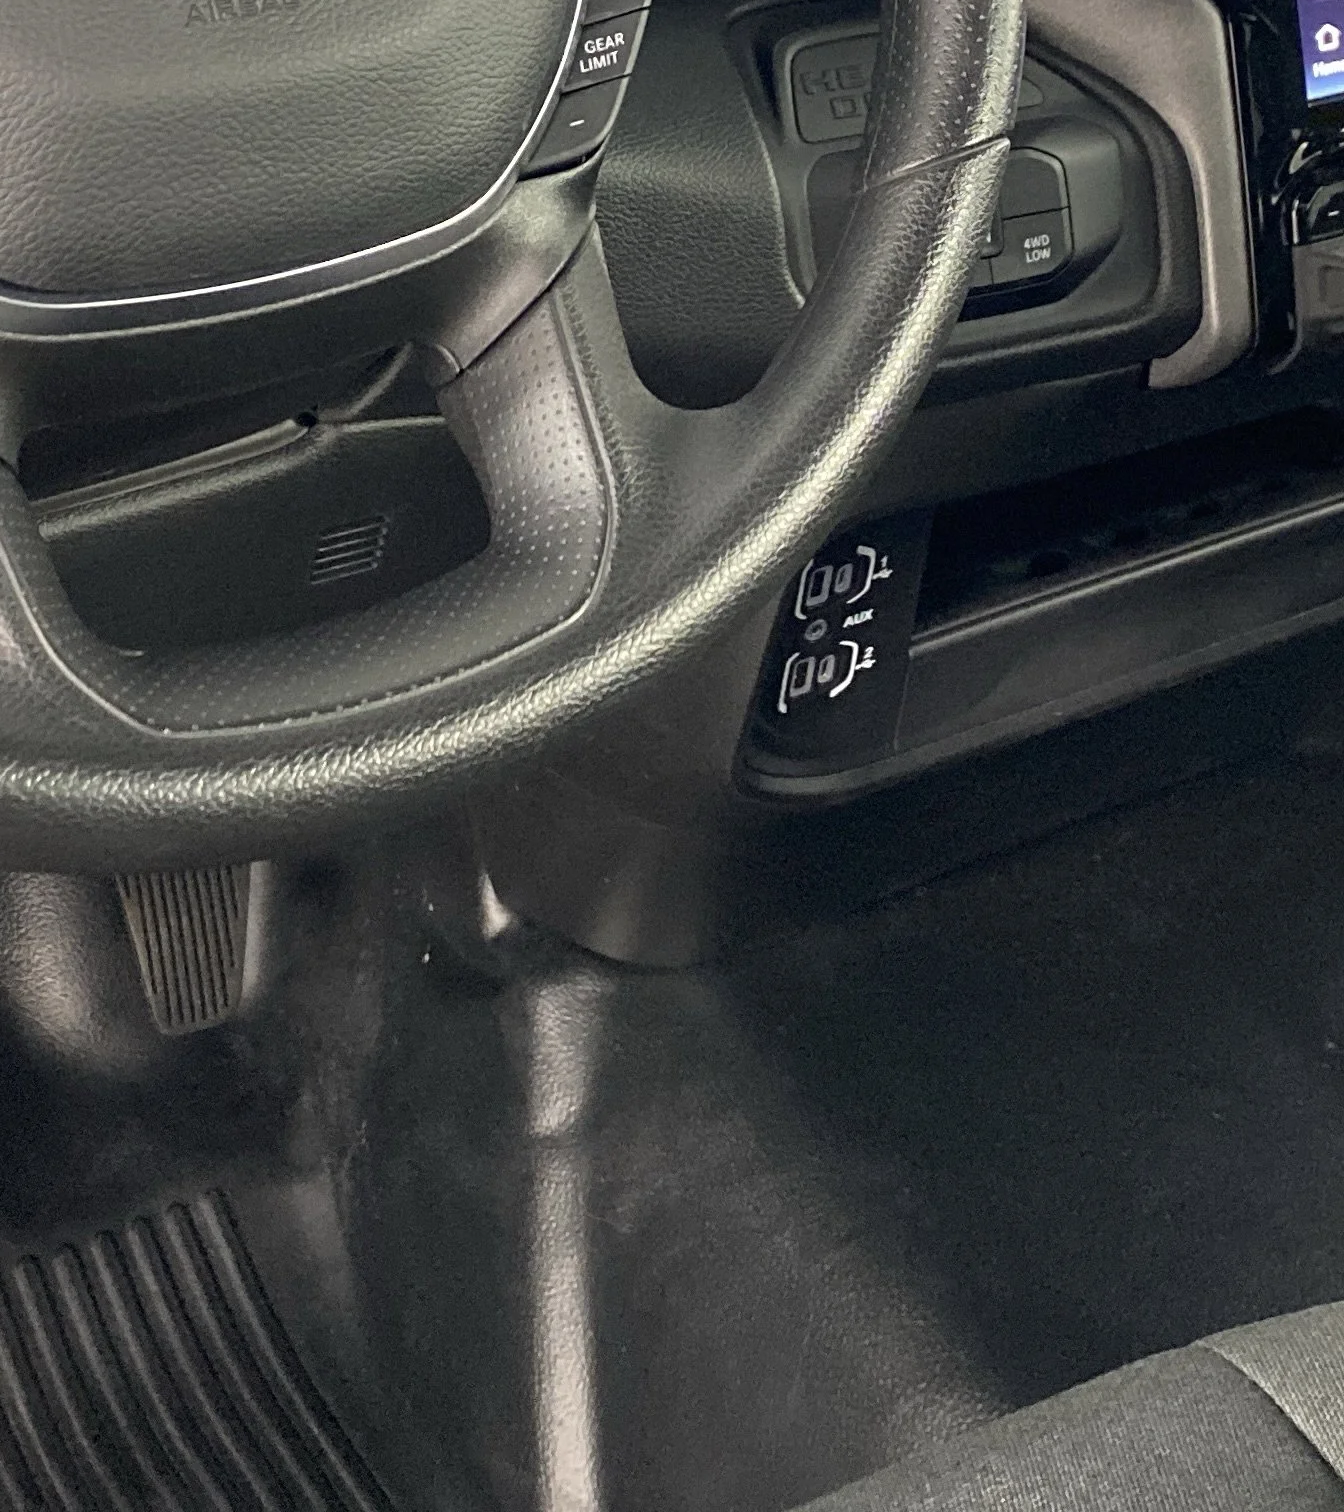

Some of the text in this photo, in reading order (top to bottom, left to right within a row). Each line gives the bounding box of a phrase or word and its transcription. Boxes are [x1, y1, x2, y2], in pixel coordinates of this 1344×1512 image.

[584, 32, 625, 54] GEAR
[579, 50, 619, 73] LIMIT
[1023, 234, 1051, 250] 4WD
[1024, 248, 1052, 264] LOW
[842, 608, 875, 629] AUX
